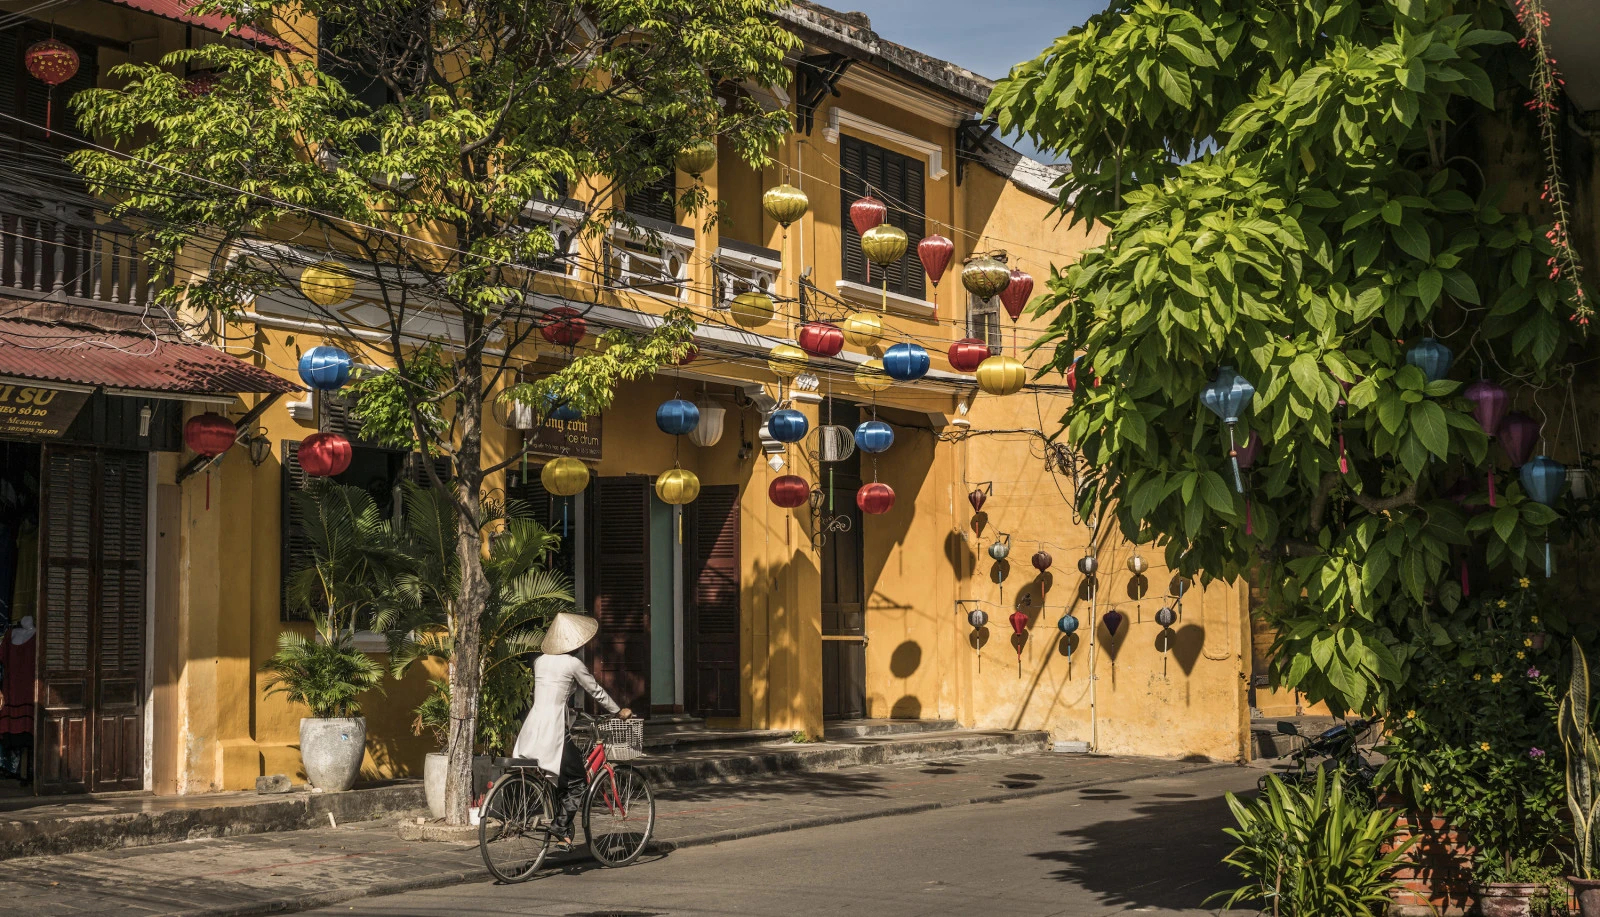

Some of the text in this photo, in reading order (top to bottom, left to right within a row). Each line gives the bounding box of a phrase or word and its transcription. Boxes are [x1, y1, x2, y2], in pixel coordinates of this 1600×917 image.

[15, 387, 58, 406] SU
[7, 416, 44, 426] Measure
[580, 434, 599, 446] drum
